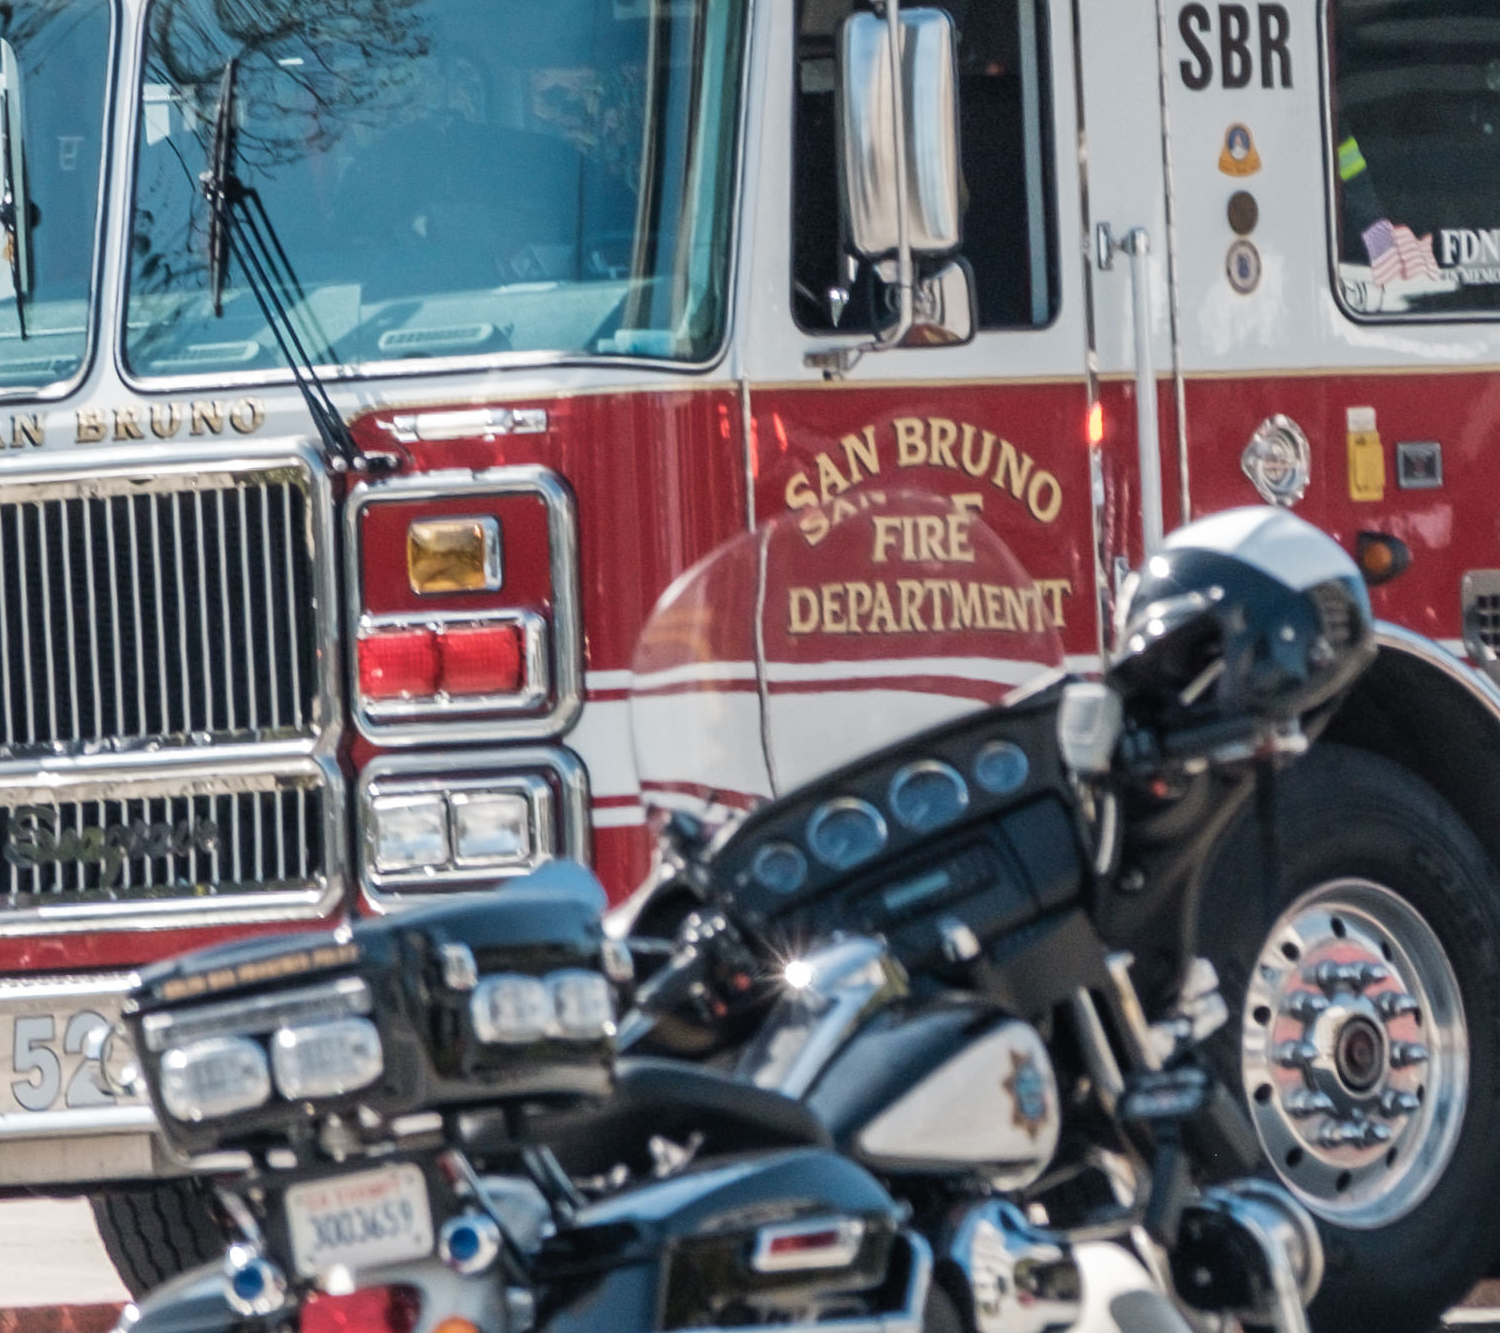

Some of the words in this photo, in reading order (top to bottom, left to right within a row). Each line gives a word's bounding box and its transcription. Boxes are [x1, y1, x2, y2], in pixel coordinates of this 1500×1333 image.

[1177, 1, 1295, 92] SBR
[74, 395, 267, 444] BRUNO
[784, 425, 880, 513] SAN
[892, 416, 1063, 523] BRUNO
[870, 493, 984, 563] FIRE
[787, 578, 1072, 634] DEPARTMENT
